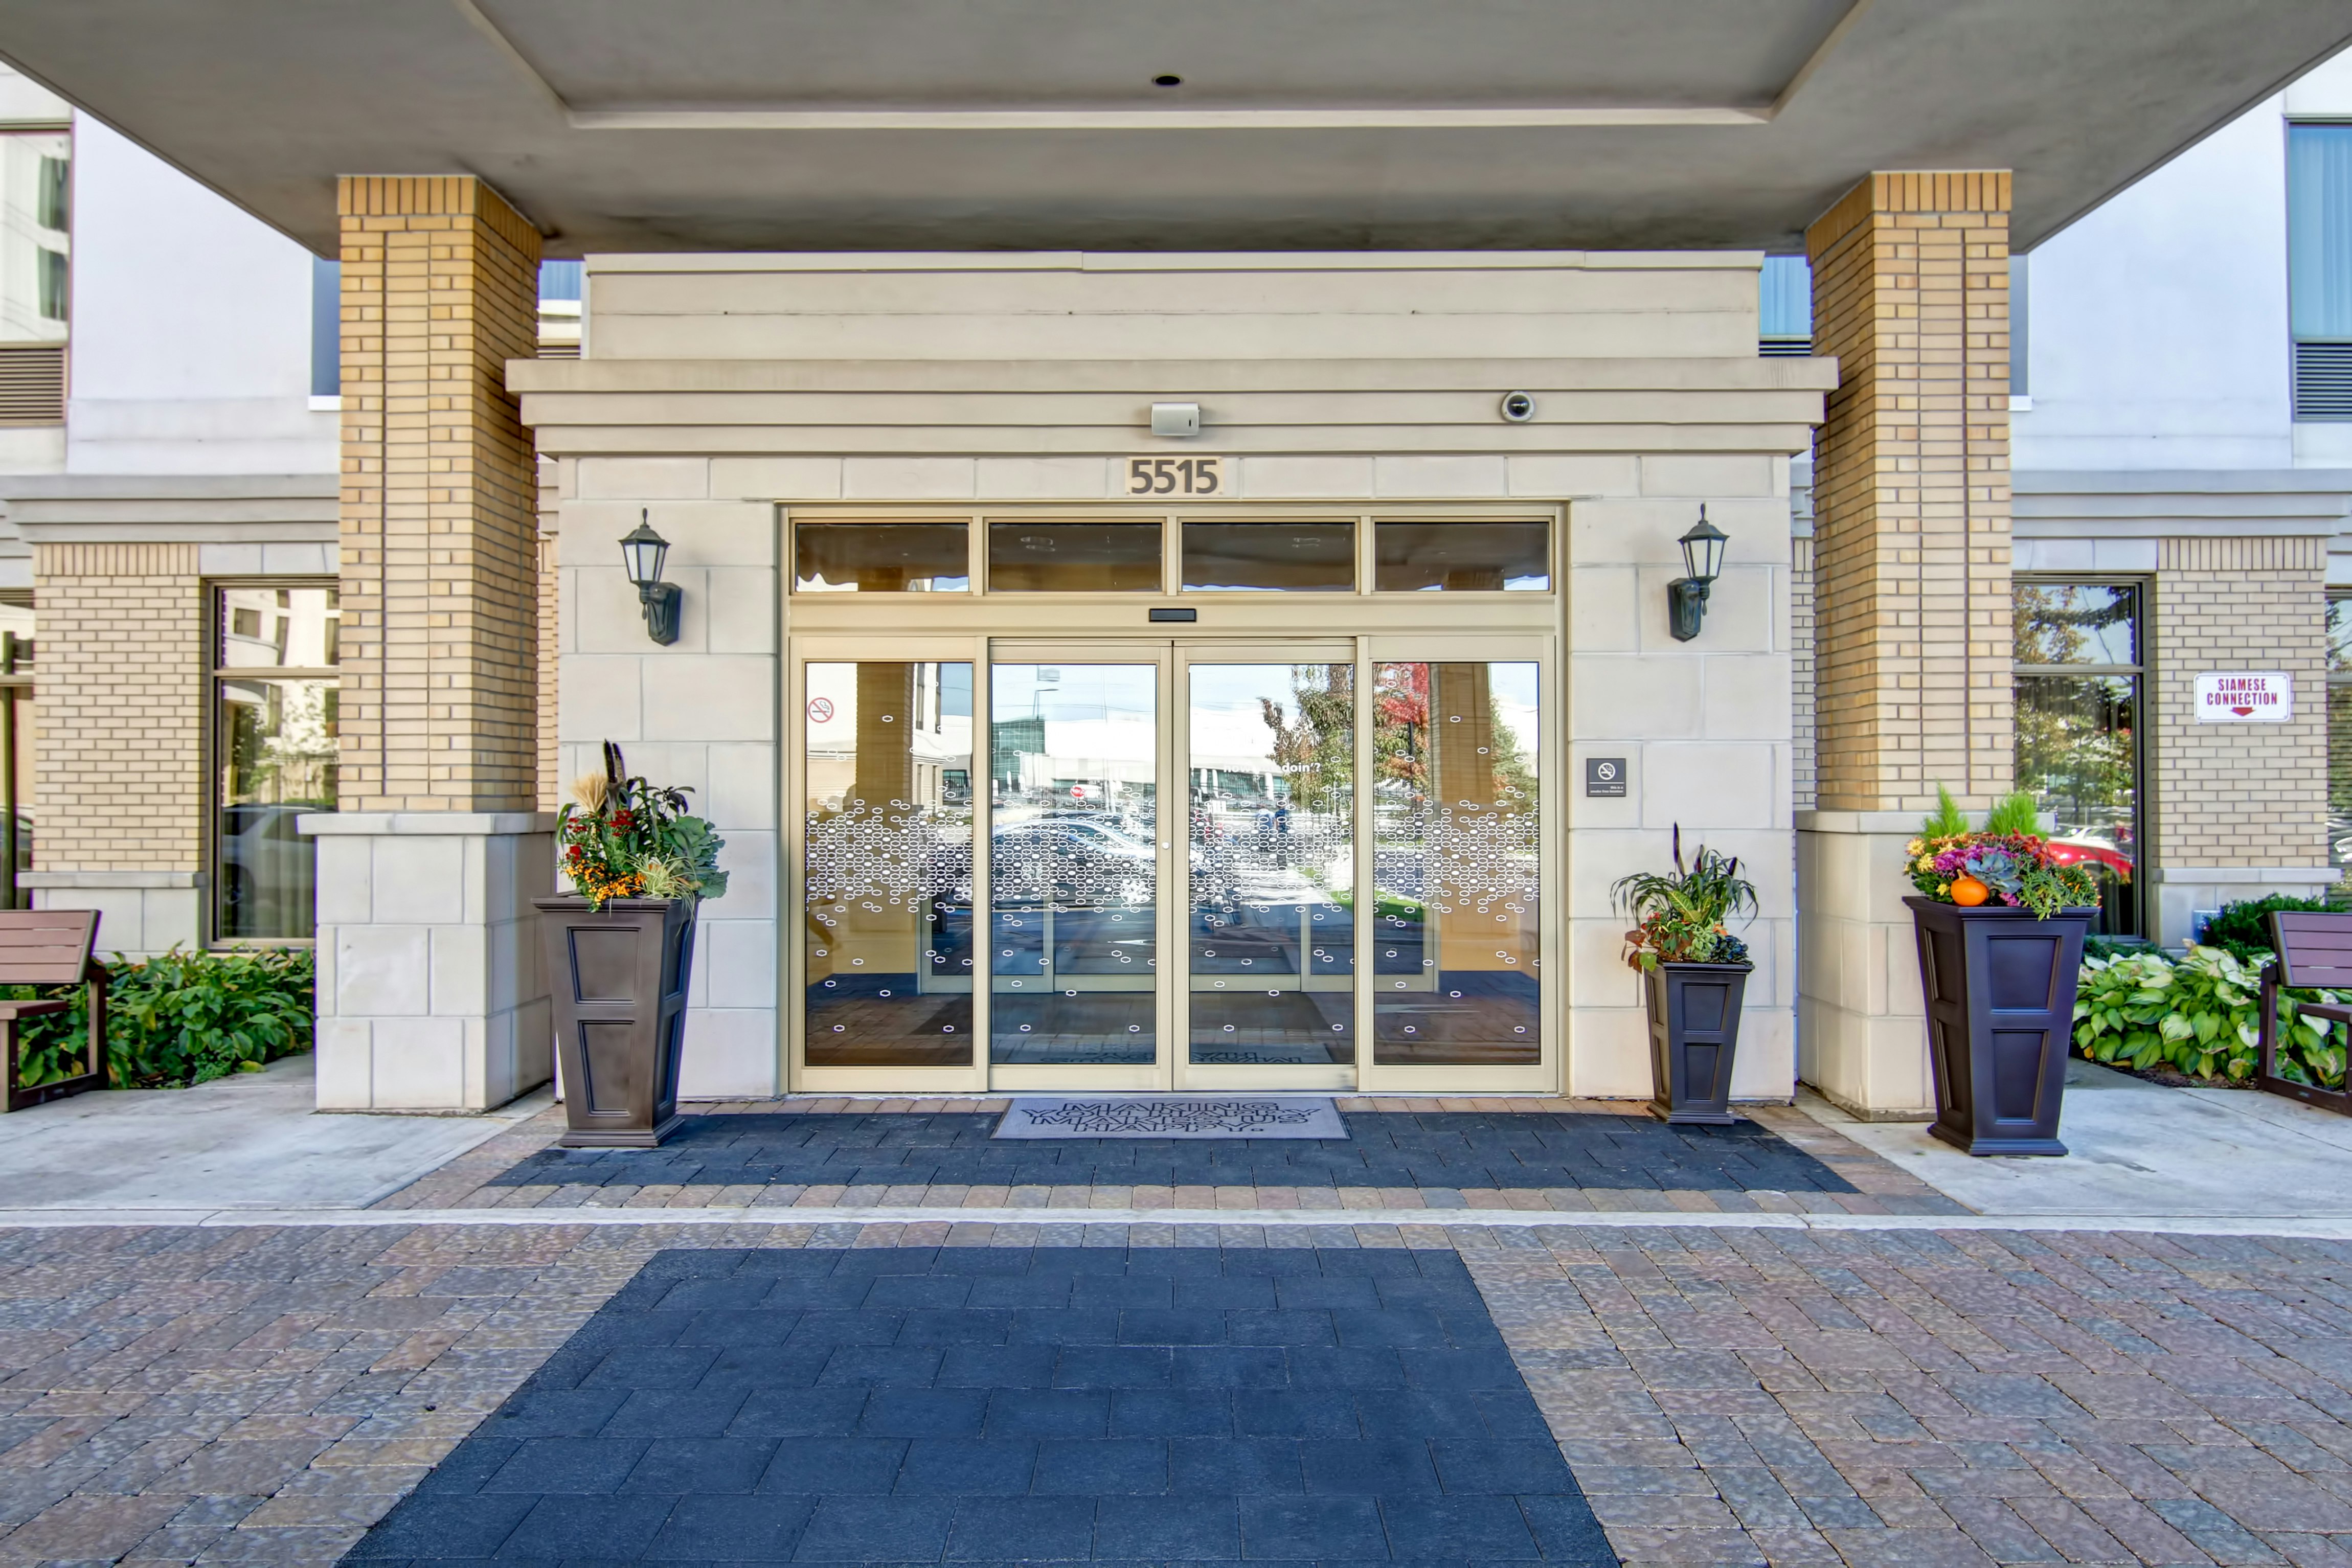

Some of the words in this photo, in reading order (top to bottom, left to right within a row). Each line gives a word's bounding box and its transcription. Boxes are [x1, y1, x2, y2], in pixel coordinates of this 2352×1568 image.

[1132, 460, 1217, 494] 5515
[2218, 678, 2266, 691] SIAMESE
[2207, 693, 2277, 705] CONNECTION
[1282, 762, 1321, 772] doin'?
[1062, 1102, 1279, 1111] MAKING
[1149, 1109, 1322, 1117] HAPPY
[1031, 1116, 1223, 1124] MAKES
[1241, 1115, 1308, 1124] US
[1074, 1123, 1264, 1131] HAPPY.
